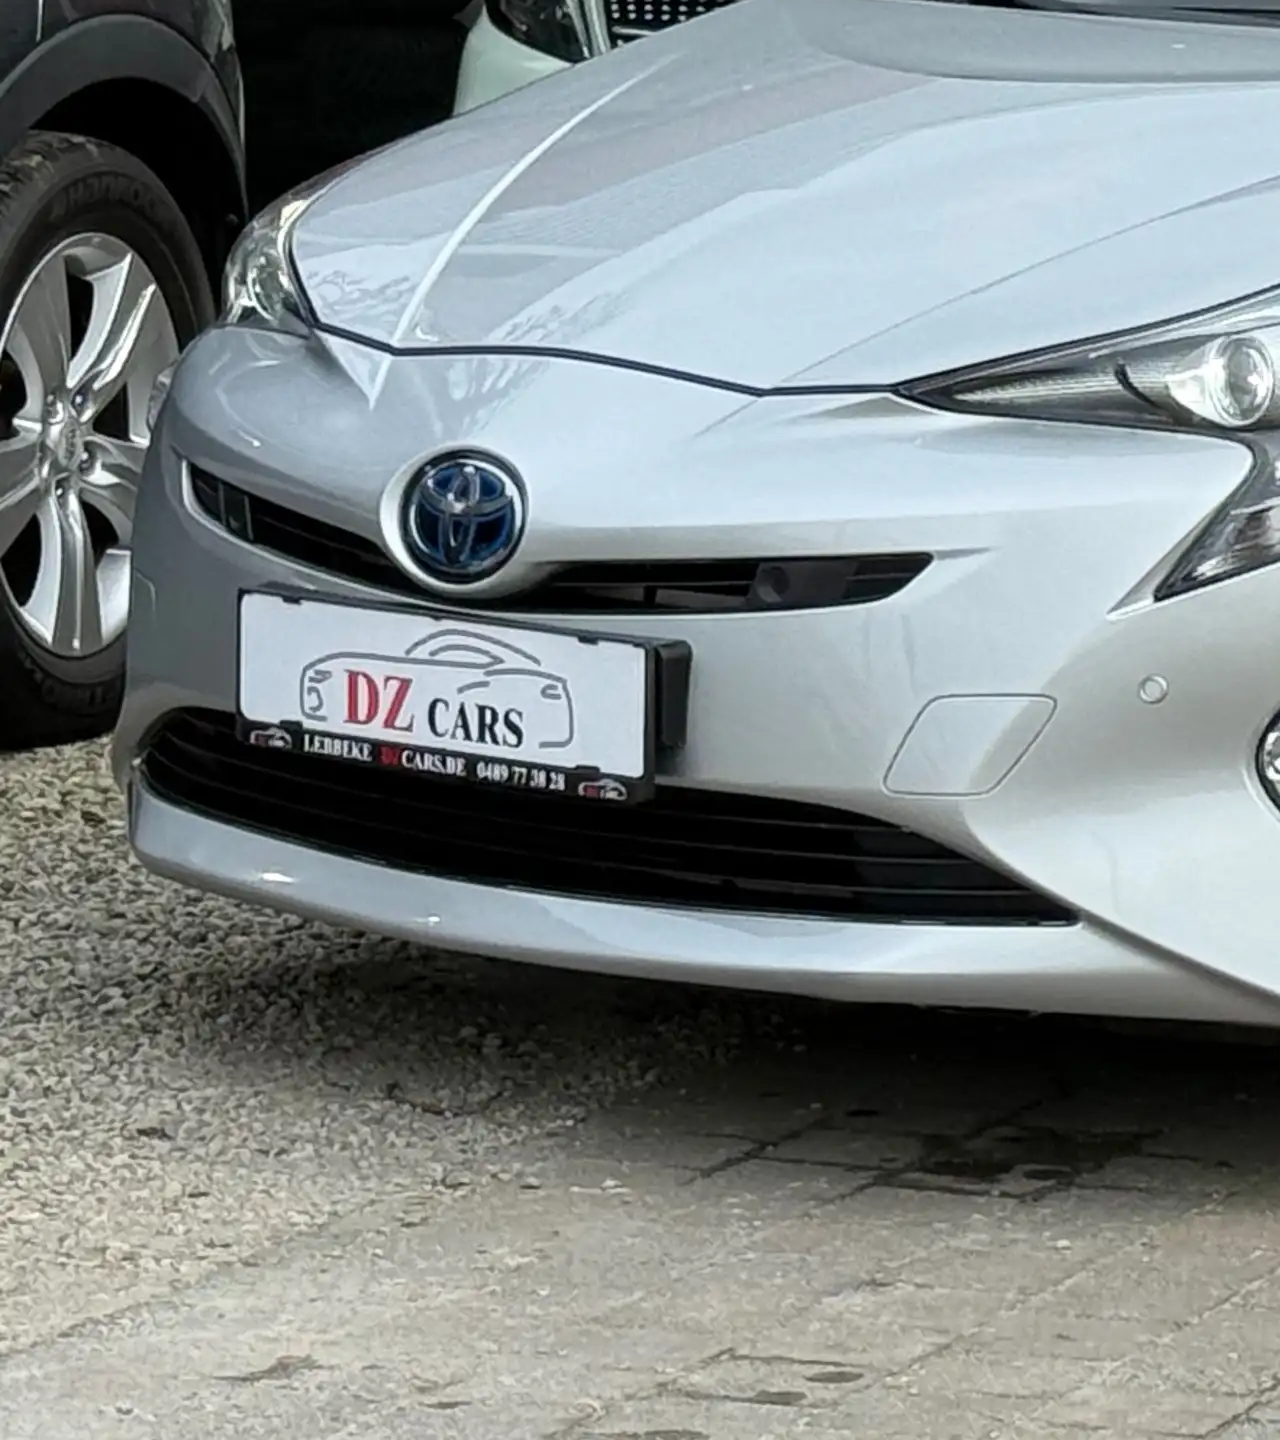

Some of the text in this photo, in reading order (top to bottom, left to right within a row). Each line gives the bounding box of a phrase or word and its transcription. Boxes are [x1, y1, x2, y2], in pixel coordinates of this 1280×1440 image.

[343, 668, 525, 749] DZ CARS
[475, 761, 509, 782] 0489
[511, 766, 528, 786] 77
